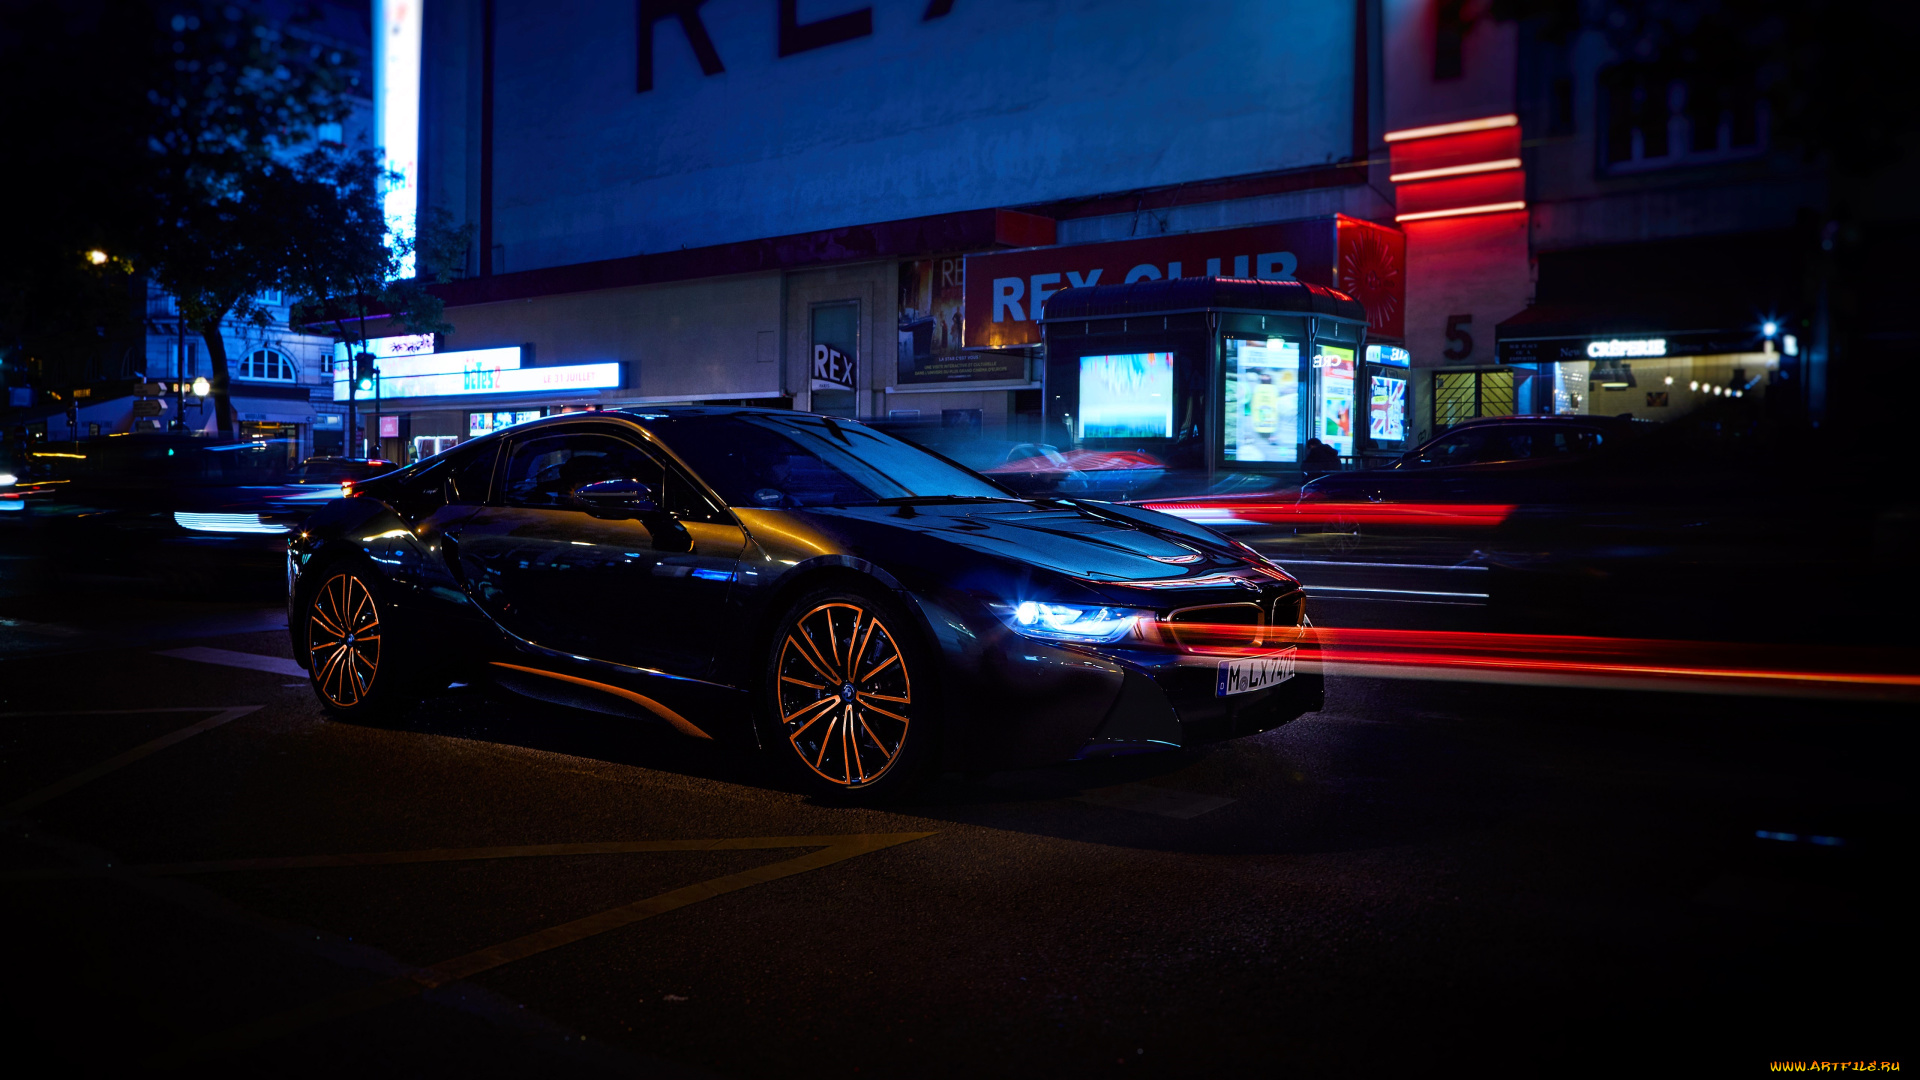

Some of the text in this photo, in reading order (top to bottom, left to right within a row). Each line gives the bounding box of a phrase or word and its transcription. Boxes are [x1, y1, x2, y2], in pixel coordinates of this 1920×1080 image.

[1443, 314, 1473, 361] 5
[565, 372, 596, 382] JUILLET
[814, 344, 853, 386] REX
[1228, 664, 1240, 692] M
[1248, 660, 1267, 688] LX
